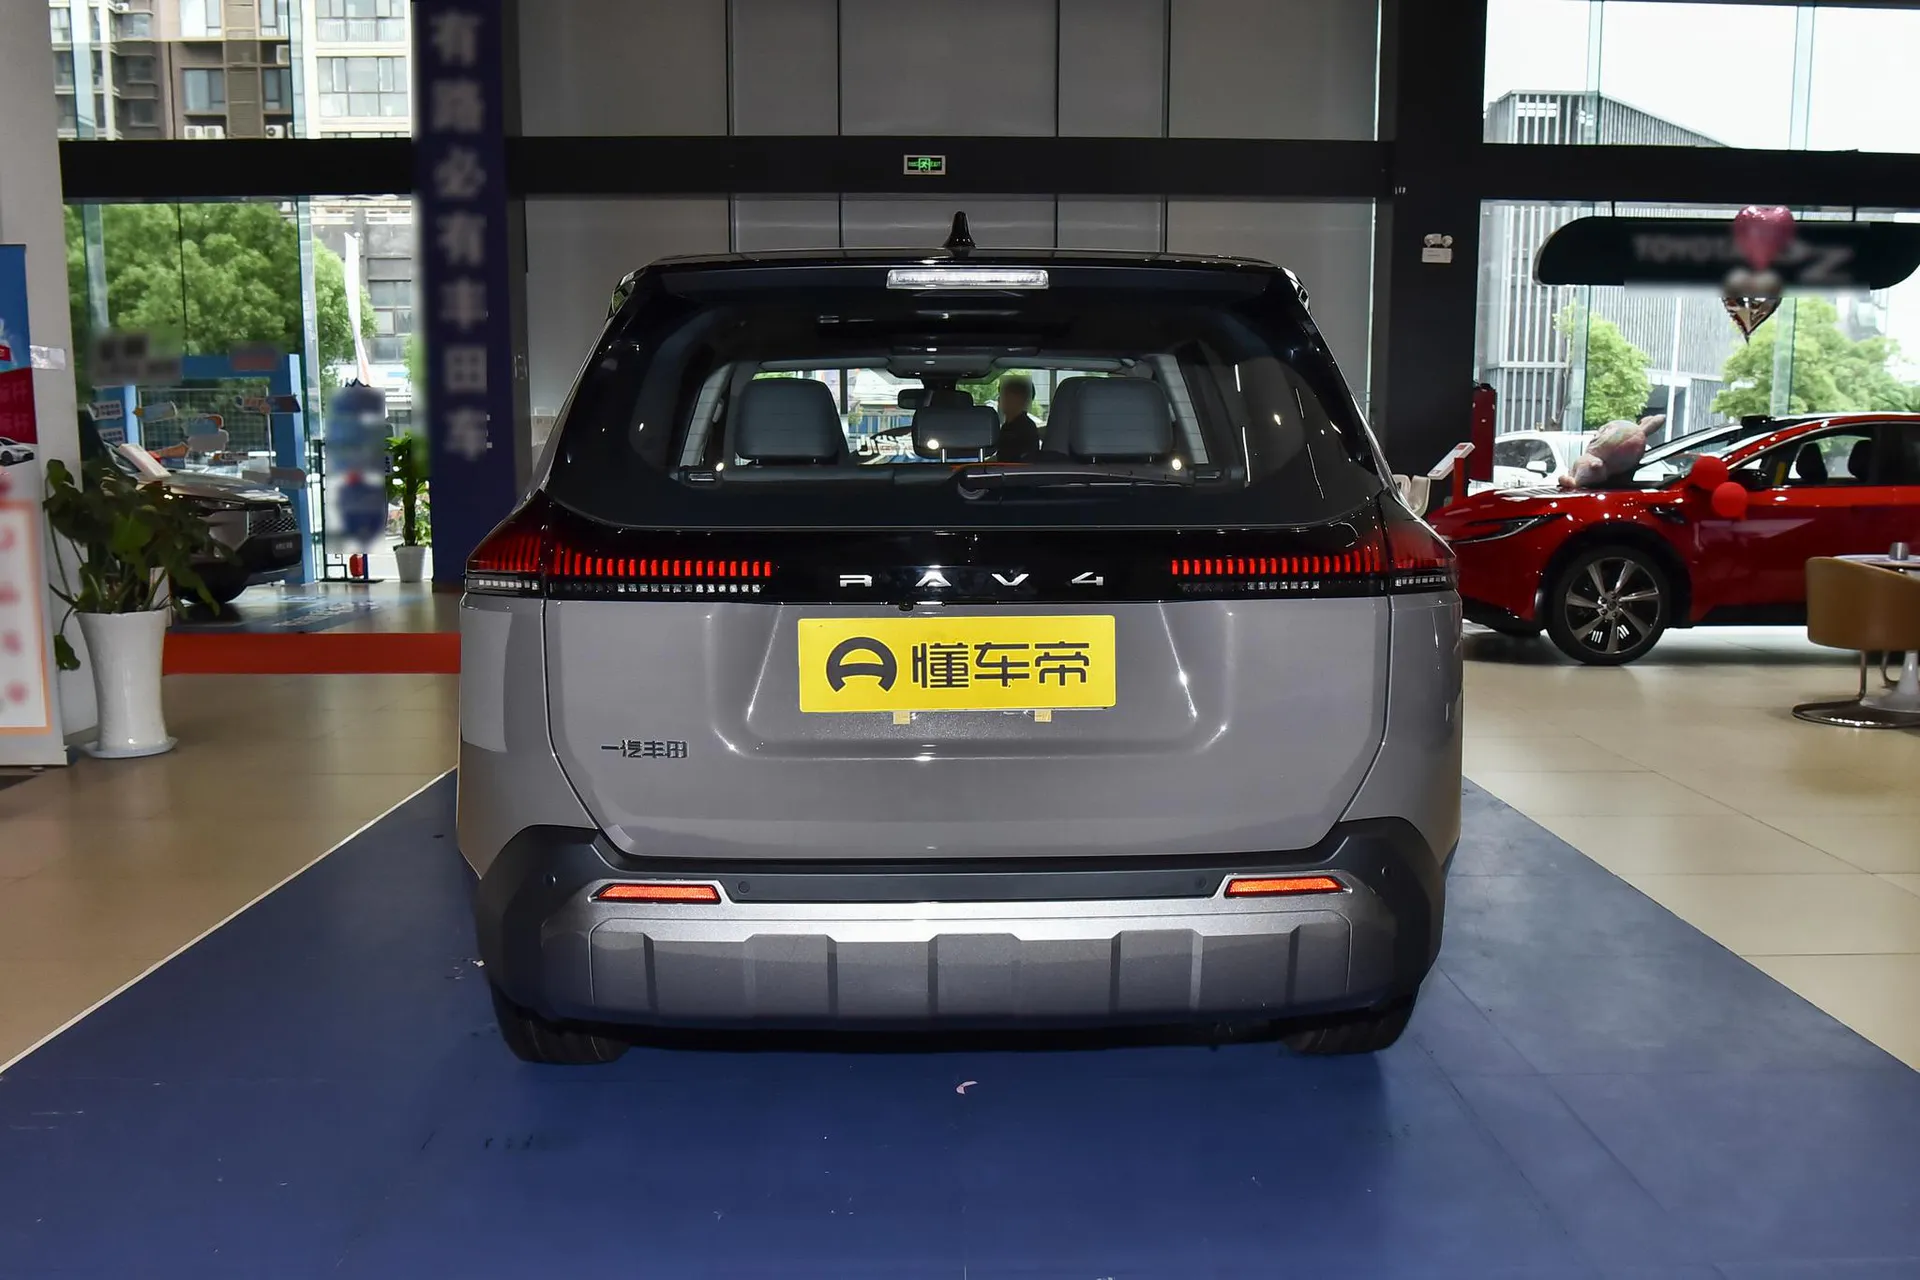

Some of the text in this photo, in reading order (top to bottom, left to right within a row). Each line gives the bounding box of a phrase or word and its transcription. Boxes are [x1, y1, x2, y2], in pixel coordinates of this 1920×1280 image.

[839, 571, 1104, 588] RAV4
[911, 641, 1091, 689] 懂车帝
[601, 739, 688, 758] 一汽丰田
